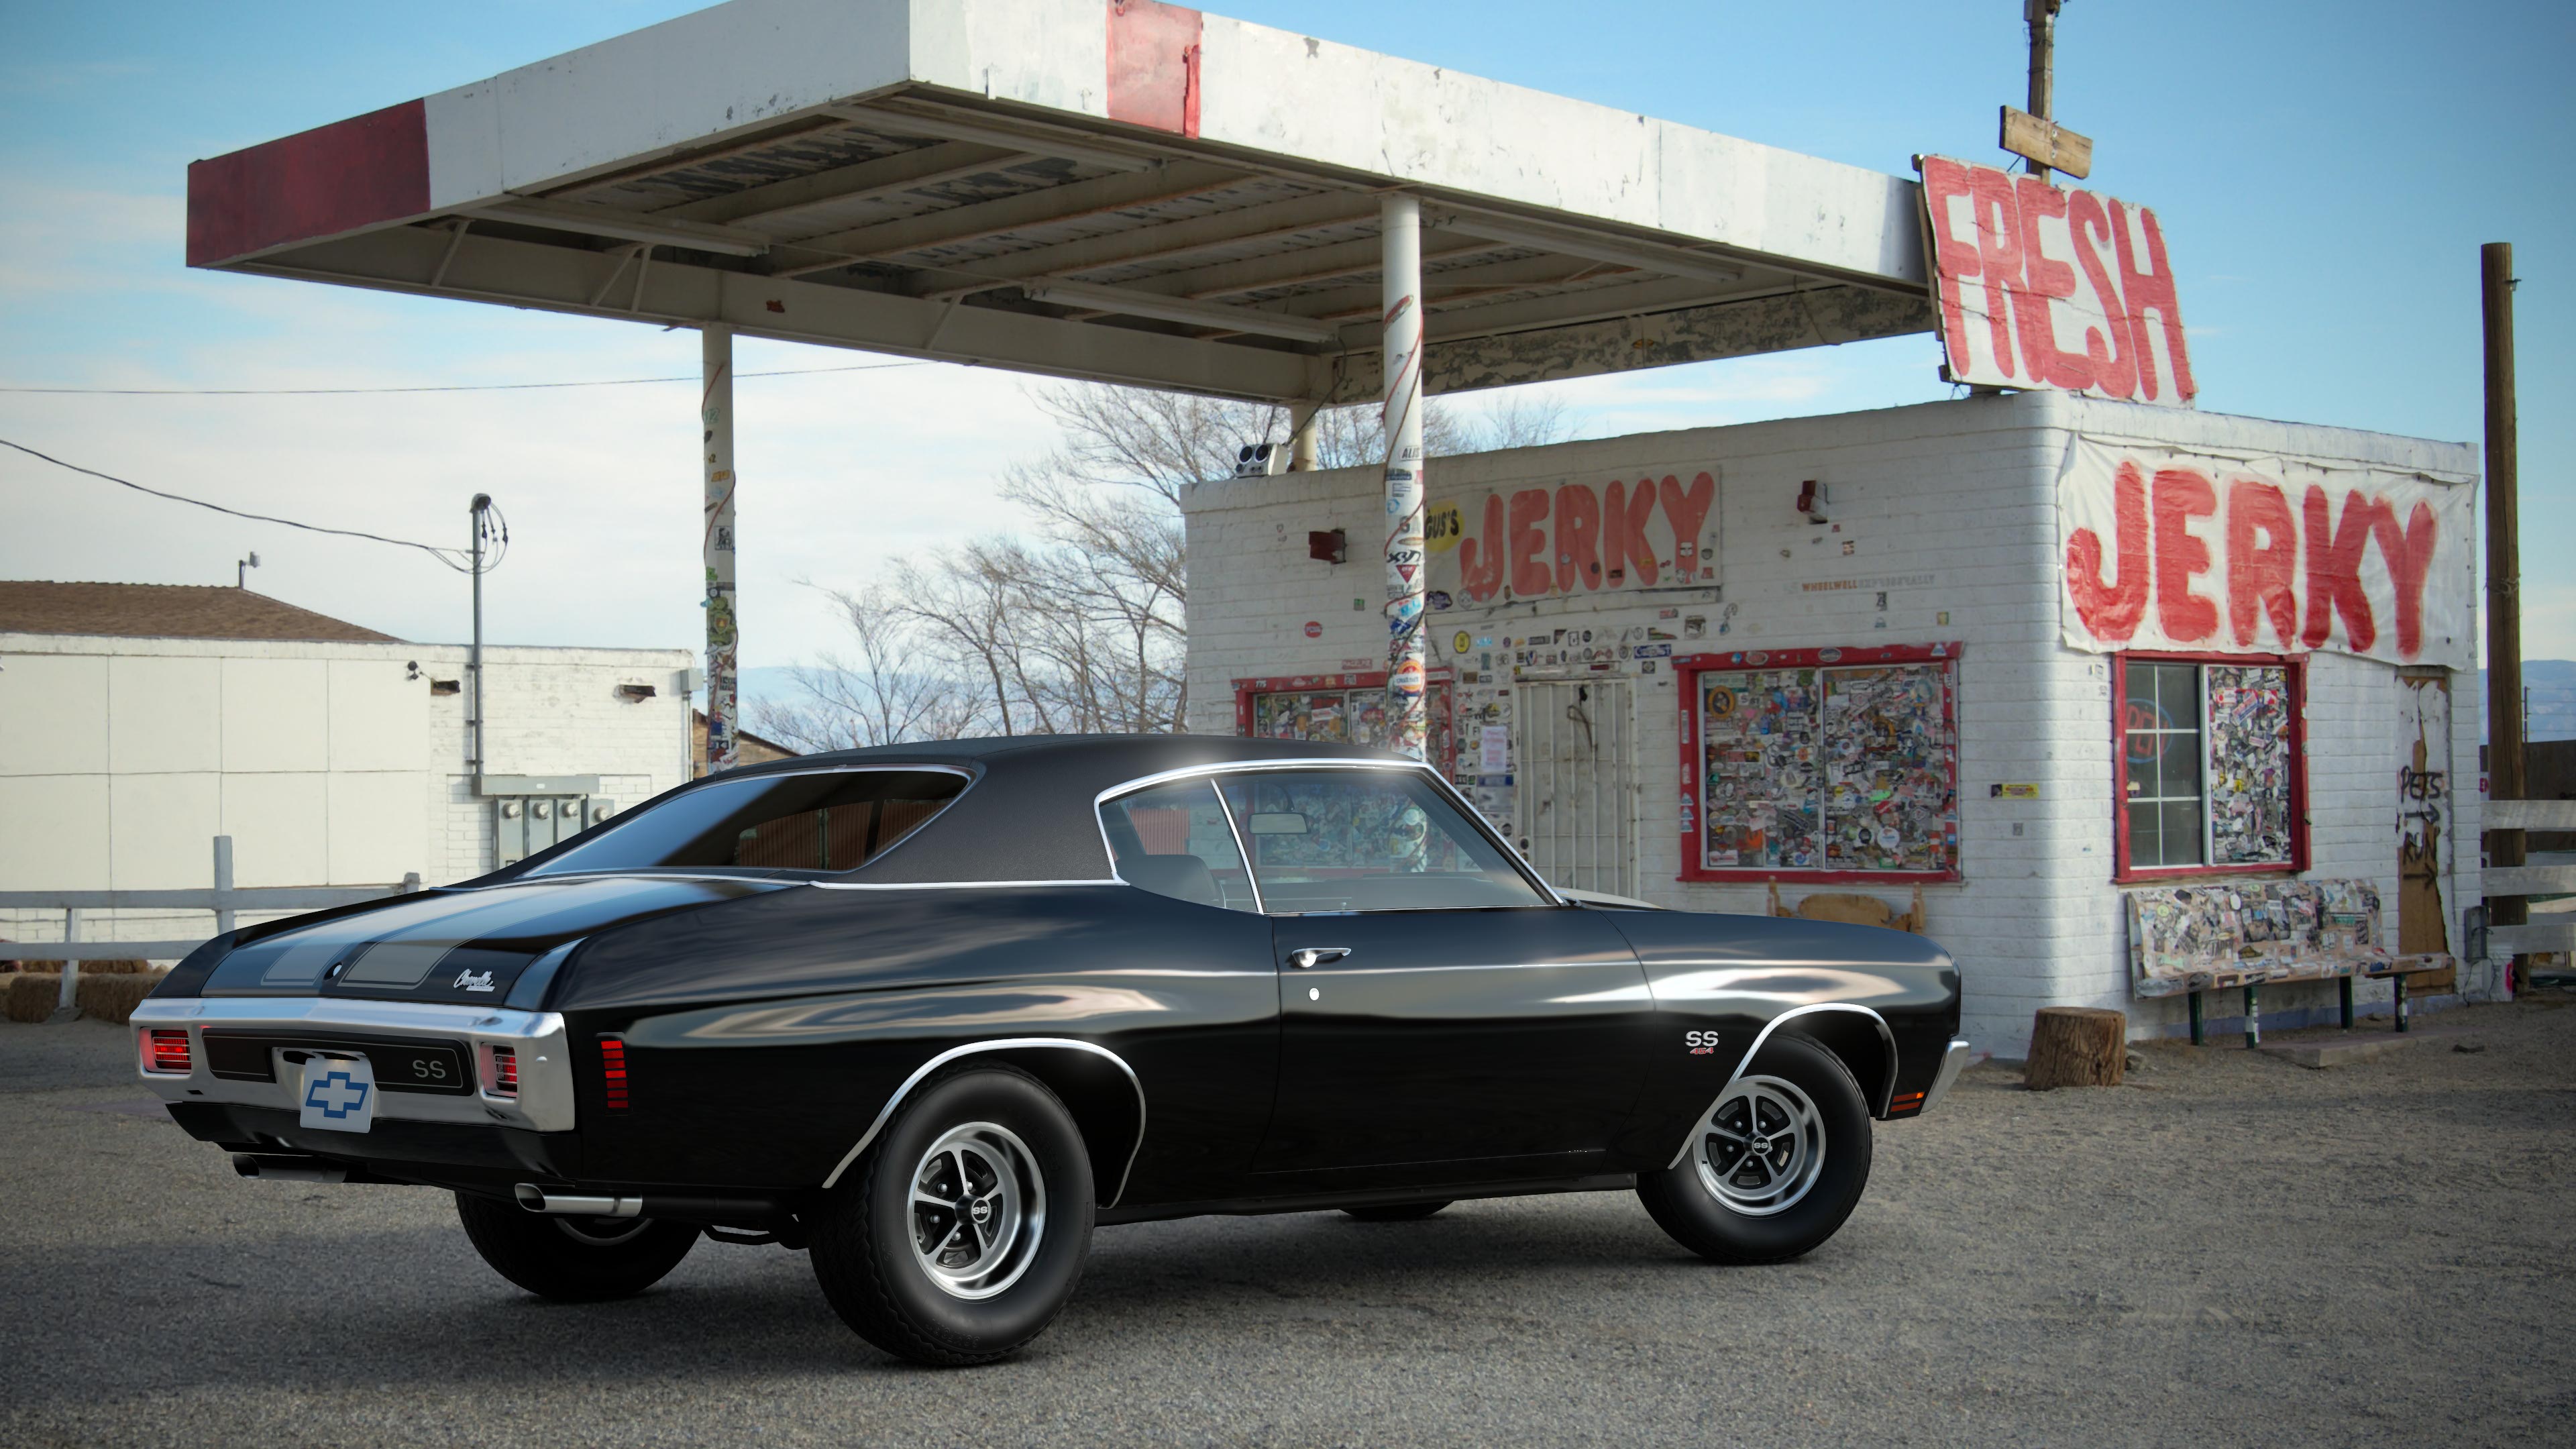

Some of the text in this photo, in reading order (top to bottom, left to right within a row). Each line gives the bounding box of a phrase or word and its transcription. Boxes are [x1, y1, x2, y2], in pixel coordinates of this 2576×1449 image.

[1925, 156, 2195, 401] FRESH
[1459, 471, 1715, 602] JERKY
[2067, 459, 2439, 663] JERKY
[2400, 765, 2444, 804] PETS
[1685, 1030, 1719, 1047] SS
[1689, 1046, 1715, 1055] 454
[413, 1059, 446, 1079] SS
[972, 1206, 988, 1215] SS
